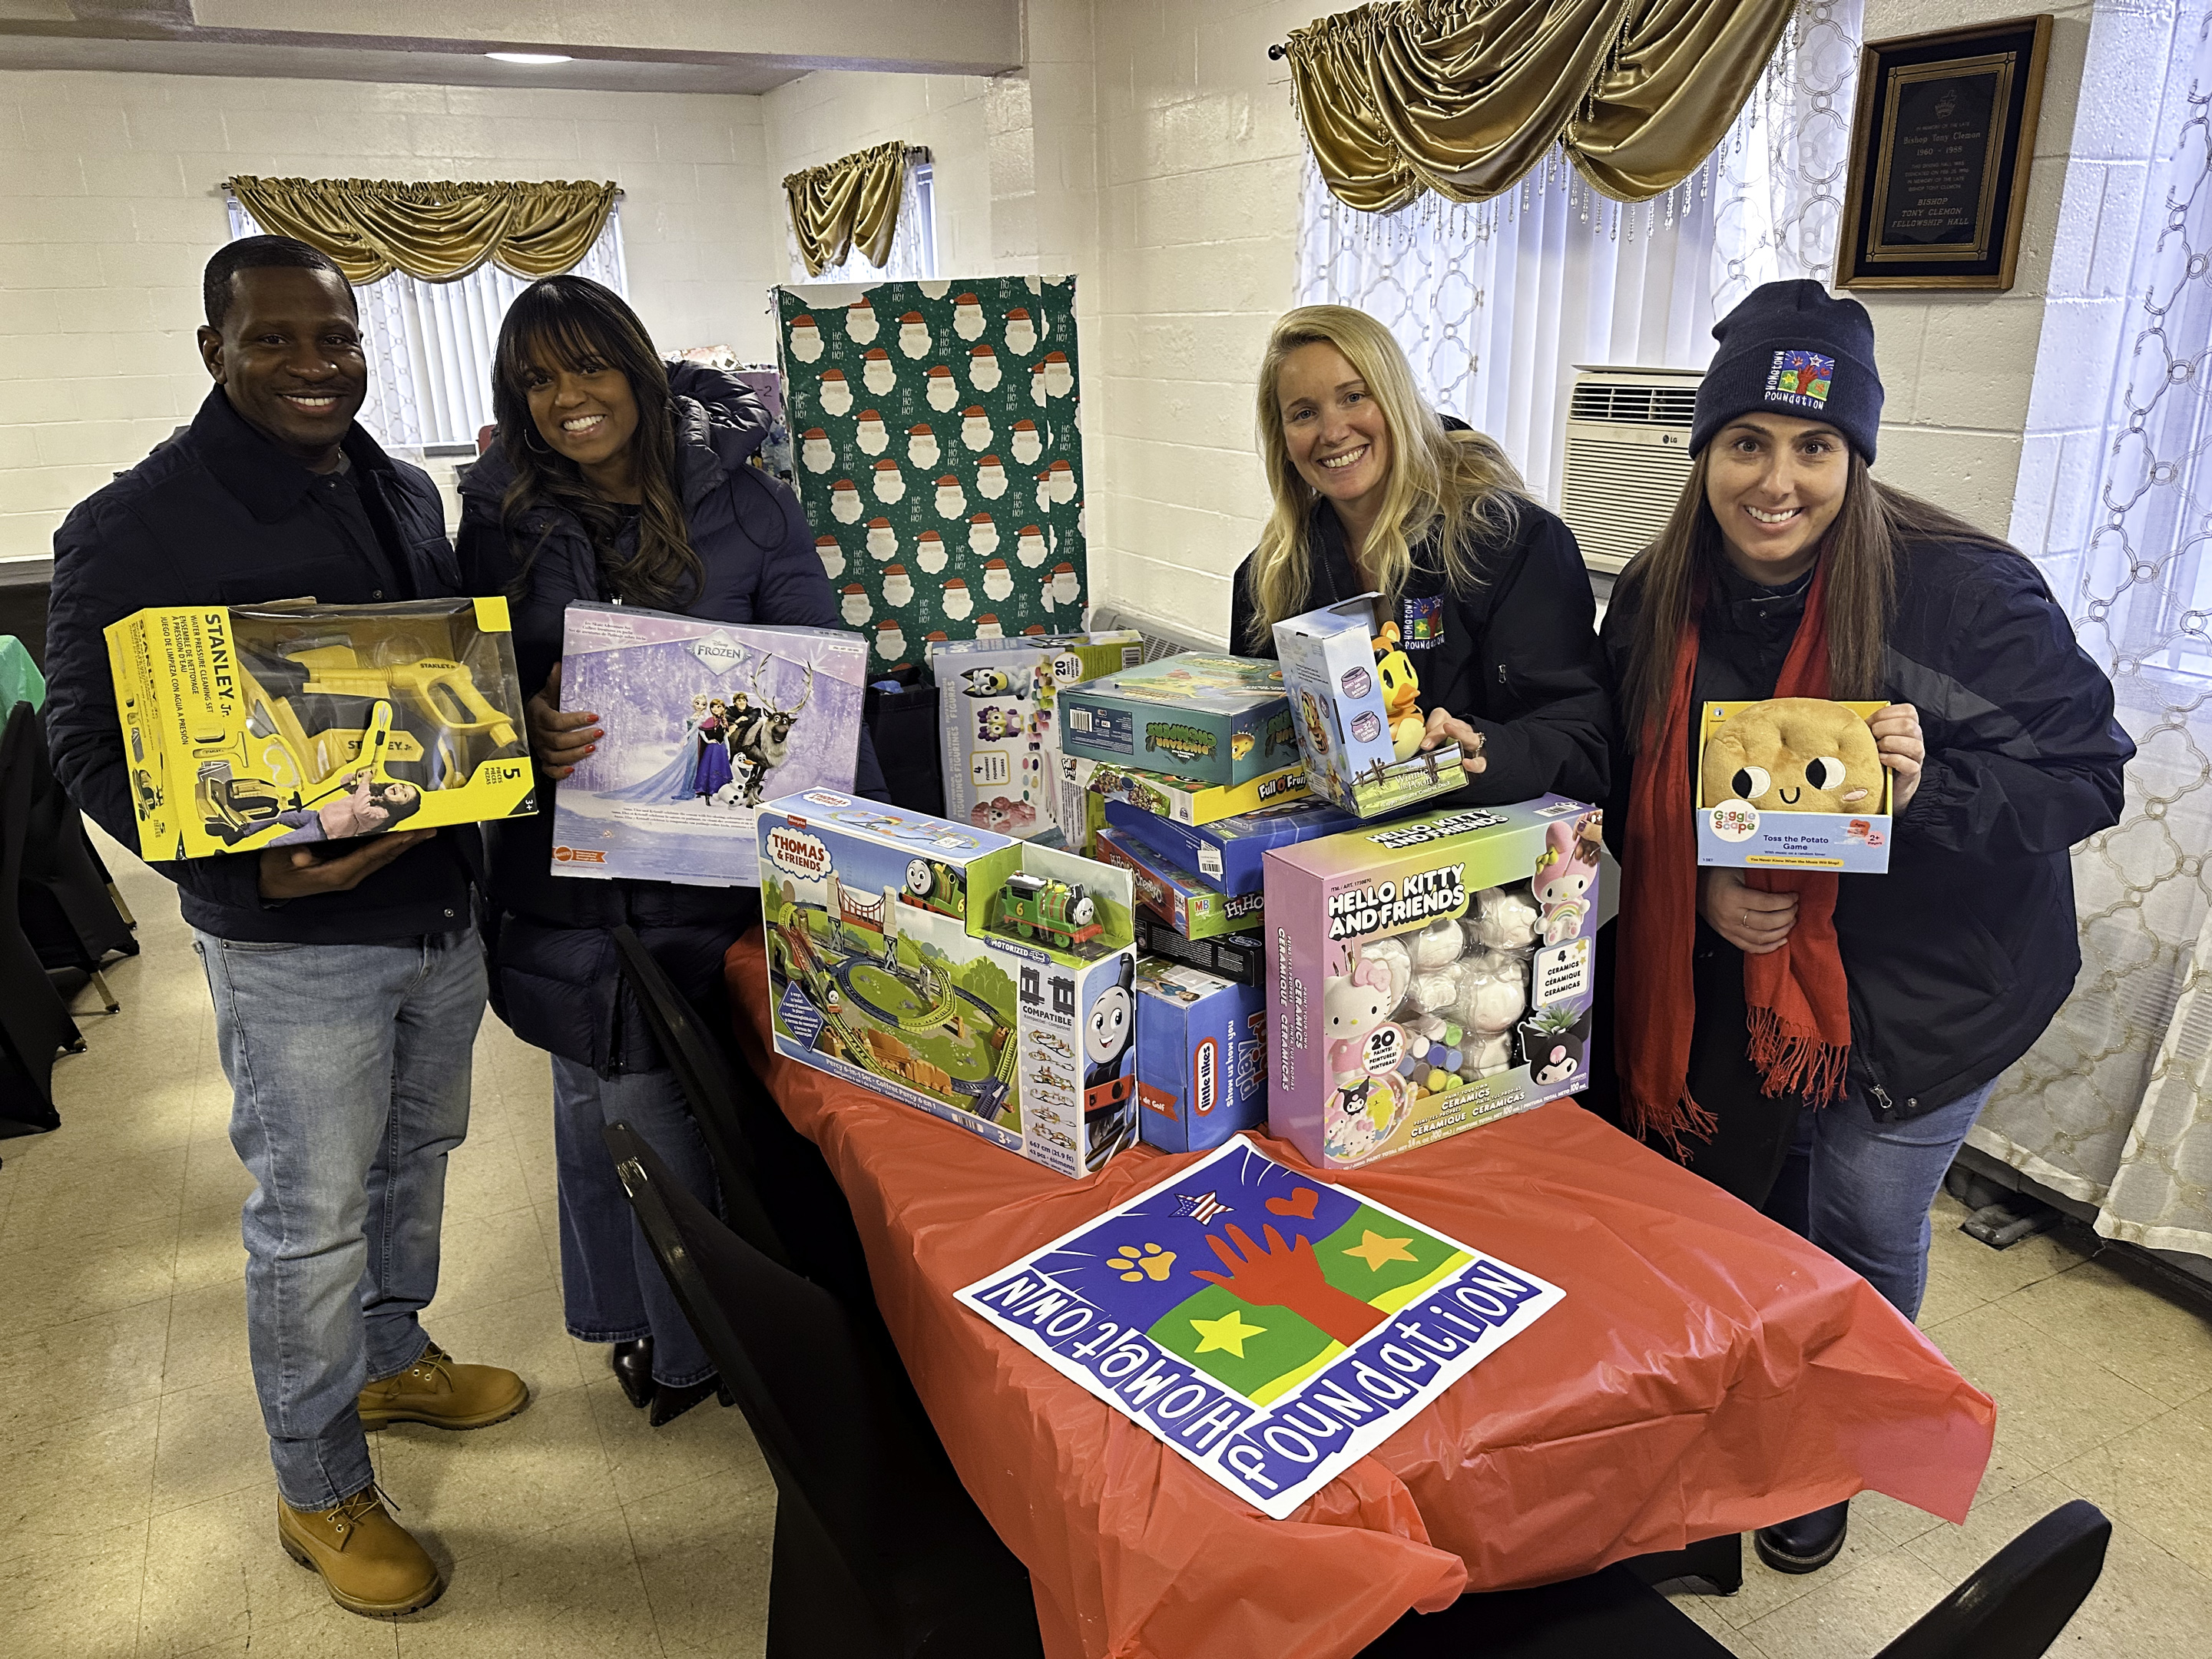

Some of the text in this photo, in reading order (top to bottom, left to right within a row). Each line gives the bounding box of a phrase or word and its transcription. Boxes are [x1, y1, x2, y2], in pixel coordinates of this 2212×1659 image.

[1903, 136, 1928, 144] Bishop
[1932, 134, 1949, 142] Tony
[1917, 197, 1949, 206] BISHOP
[1901, 207, 1963, 217] TONY CLEMON
[1892, 219, 1943, 228] FELLOWSHIP
[893, 284, 902, 293] HO
[892, 293, 905, 303] HO!
[1058, 314, 1067, 323] HO
[1058, 324, 1066, 333] HO
[1056, 333, 1068, 343] HO!
[1007, 384, 1016, 392] HO
[1007, 393, 1016, 402] HO
[1006, 402, 1018, 411] HO!
[843, 444, 853, 452] HO
[843, 453, 853, 462] HO
[843, 462, 855, 471] HO!
[161, 617, 170, 636] JUEGO
[190, 615, 200, 637] WATER
[165, 637, 172, 647] DE
[173, 622, 187, 673] PRESSION D'EAU
[179, 615, 200, 695] ENSEMBLE DE NETTOYAGE
[195, 638, 206, 667] PRESSURE
[698, 645, 740, 659] FROZEN
[166, 647, 177, 677] LIMPIEZA
[204, 614, 235, 717] STANLEY Jr.
[1055, 661, 1066, 676] 20
[200, 668, 211, 700] CLEANING
[174, 694, 184, 711] AGUA
[947, 680, 958, 718] FIGURAS
[178, 718, 189, 745] PRESIÓN
[1362, 721, 1373, 730] 32
[348, 740, 401, 750] STEY
[951, 726, 962, 772] FIGURINES
[502, 767, 522, 779] 5
[1395, 769, 1429, 783] Winnie
[1259, 780, 1276, 798] Full
[1286, 773, 1306, 788] Frui
[1408, 776, 1433, 790] Pooh
[954, 773, 965, 818] FIGURINES
[525, 799, 534, 810] 3+
[1714, 810, 1756, 823] Giggle
[1366, 809, 1492, 843] HELLO KITTY
[1383, 815, 1509, 849] AND FRIENDS
[772, 833, 825, 862] THOMAS
[777, 849, 821, 872] & FRIENDS
[1328, 863, 1465, 917] HELLO KITTY
[957, 898, 965, 913] 6
[1015, 901, 1025, 916] 6
[1195, 899, 1210, 911] MB
[1328, 884, 1465, 939] AND FRIENDS
[992, 939, 1028, 956] MOTORIZED
[1558, 950, 1566, 962] 4
[1547, 961, 1579, 975] CERAMICS
[1022, 1005, 1072, 1026] COMPATIBLE
[1294, 978, 1303, 1050] CERAMICS
[1371, 1030, 1395, 1051] 20
[1369, 1051, 1397, 1064] PEINTURES!
[1373, 1046, 1392, 1056] PAINTS!
[1225, 1020, 1237, 1108] show us how you
[826, 1058, 843, 1071] Percy
[862, 1073, 872, 1082] Set
[876, 1078, 899, 1094] Coffret
[899, 1088, 917, 1102] Percy
[1200, 1045, 1210, 1108] little tikes
[1143, 1097, 1165, 1111] de Golf
[1442, 1088, 1491, 1111] CERAMICS
[998, 1130, 1012, 1144] 3+
[1029, 1141, 1041, 1149] 667
[1041, 1145, 1051, 1154] cm
[1037, 1151, 1046, 1160] pcs
